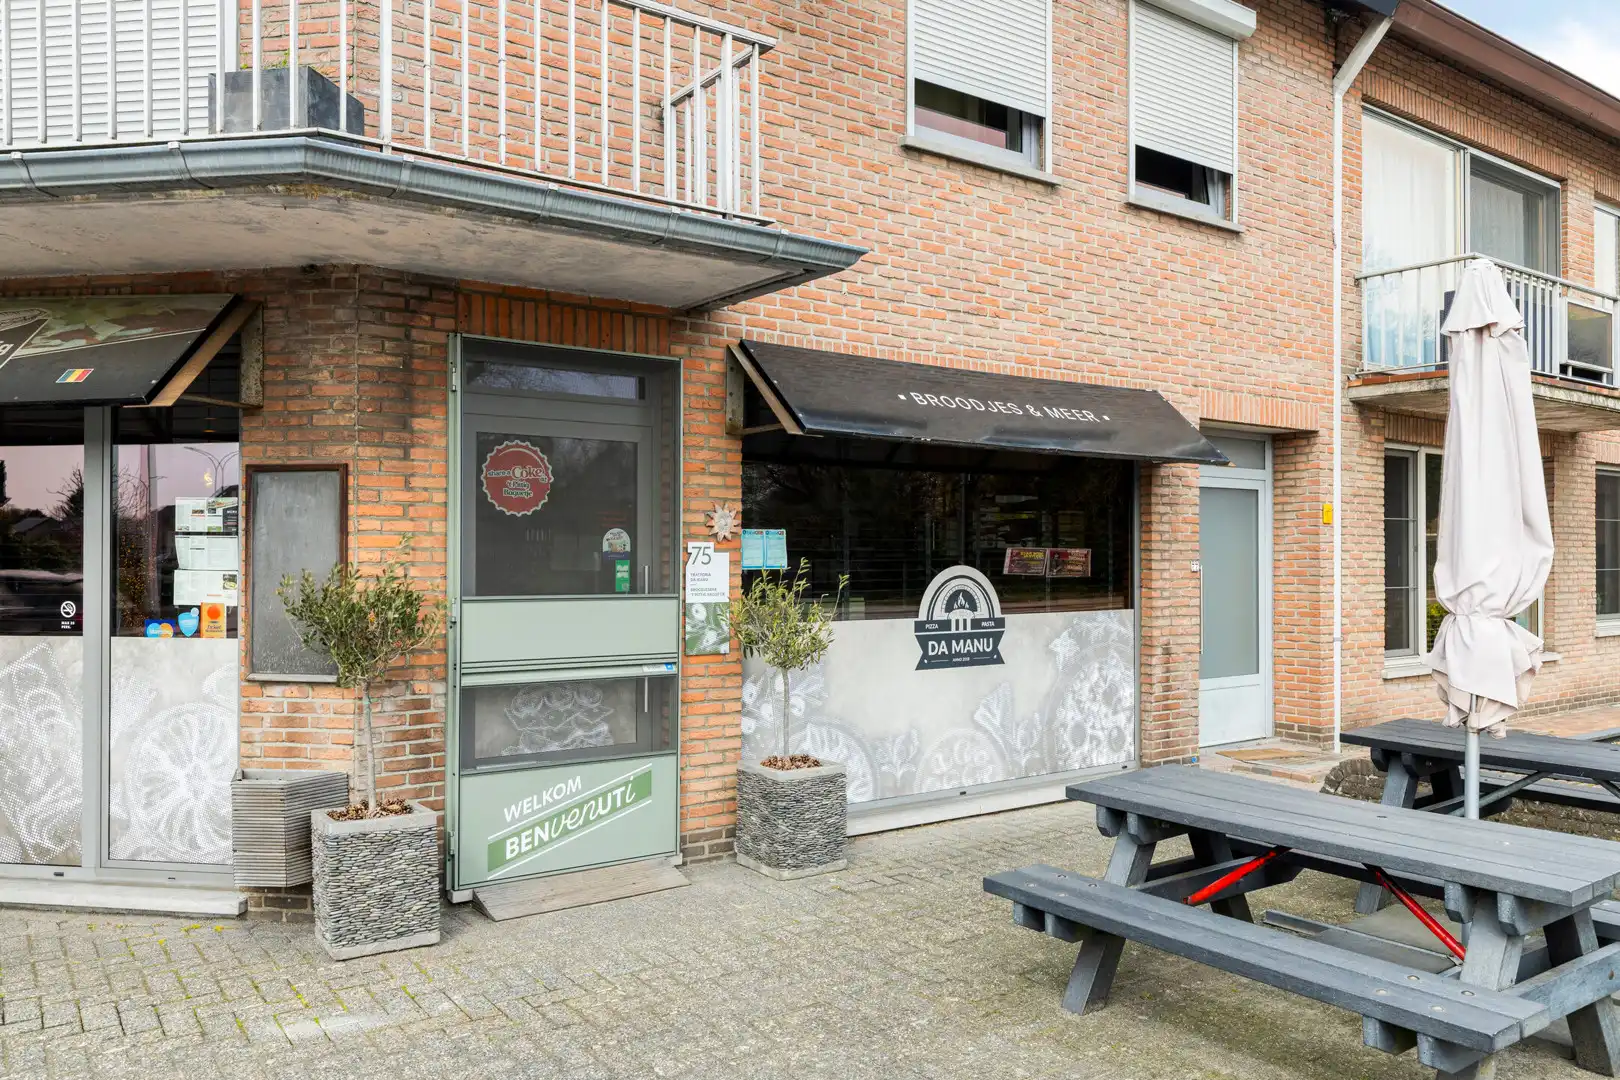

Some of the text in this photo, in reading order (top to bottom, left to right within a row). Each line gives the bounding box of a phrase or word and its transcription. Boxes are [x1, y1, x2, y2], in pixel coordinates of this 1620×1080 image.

[910, 392, 1100, 423] BROODJES & MEER
[511, 465, 544, 479] Coke
[691, 546, 712, 565] 75
[928, 637, 993, 656] DA MANU
[504, 775, 582, 822] WELKOM
